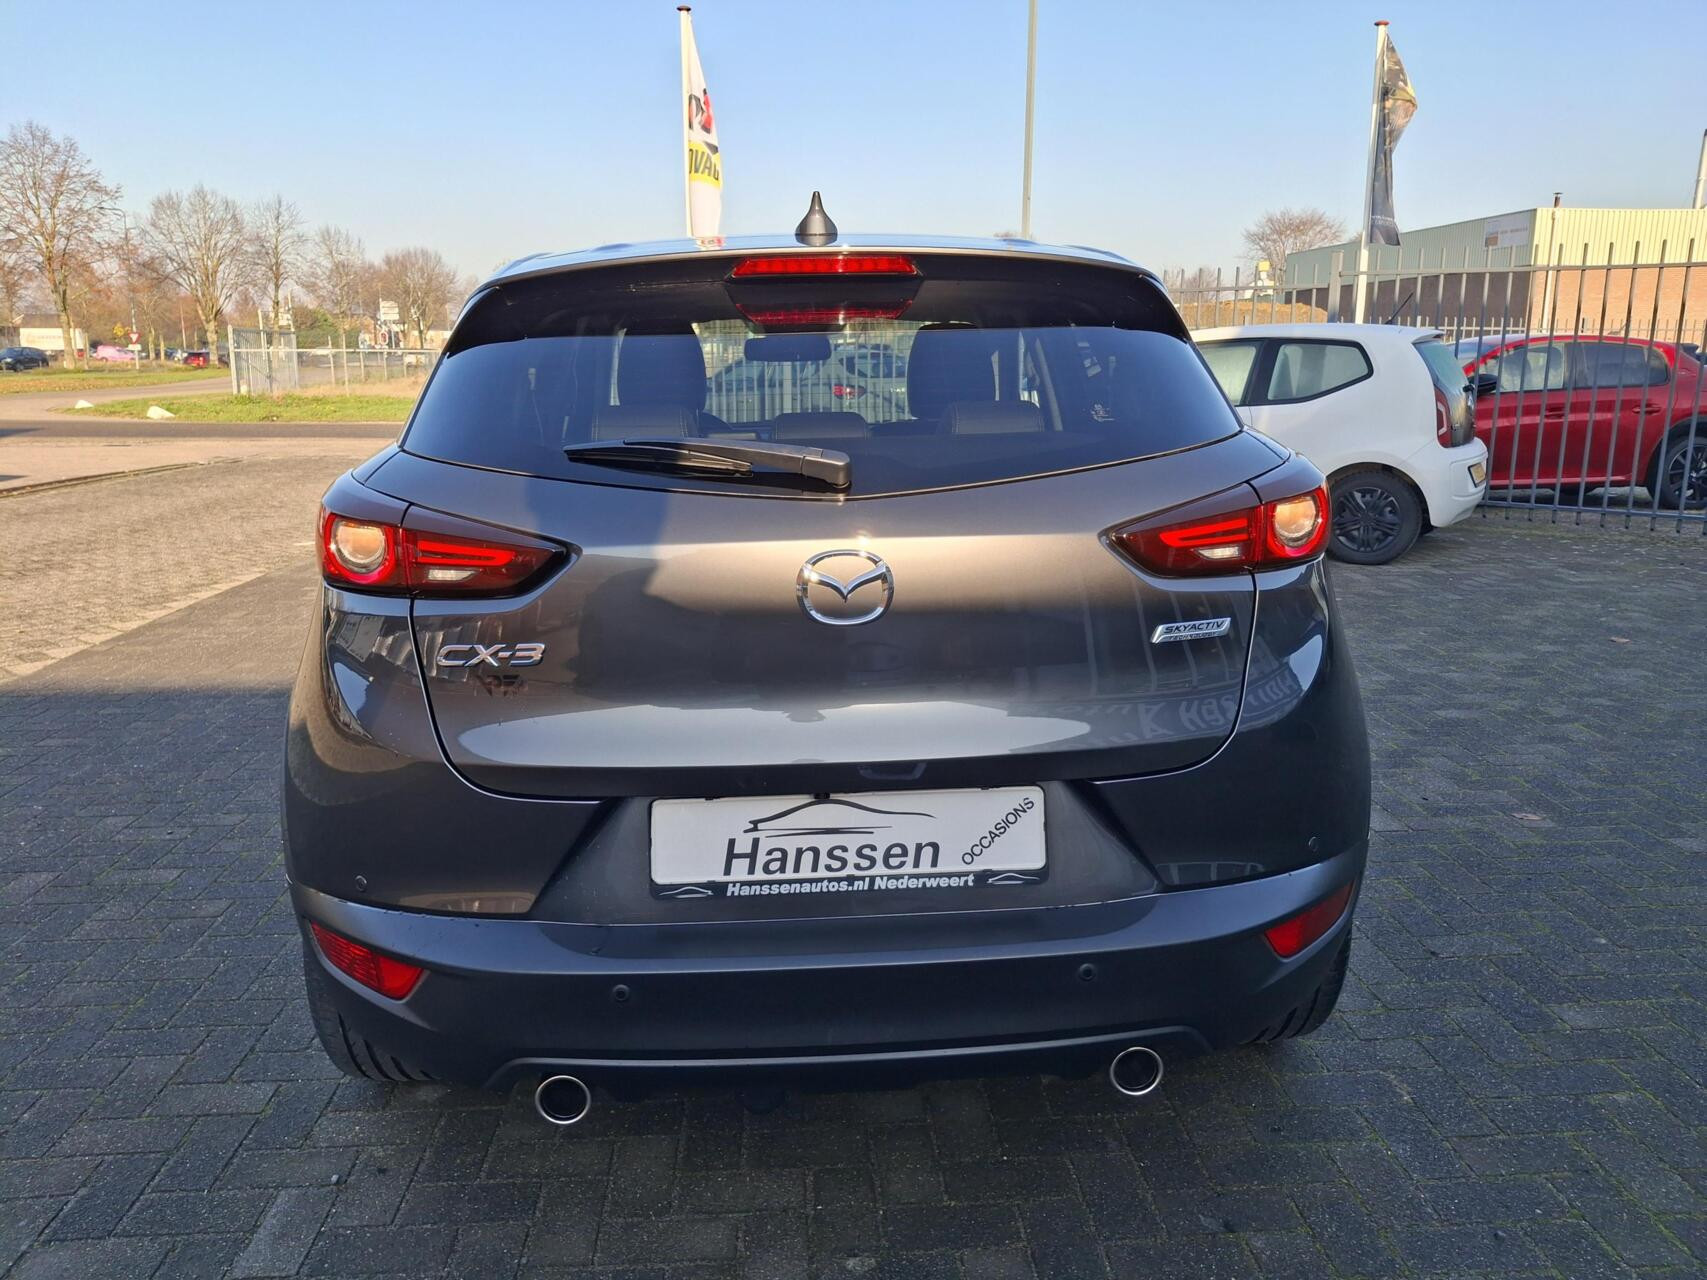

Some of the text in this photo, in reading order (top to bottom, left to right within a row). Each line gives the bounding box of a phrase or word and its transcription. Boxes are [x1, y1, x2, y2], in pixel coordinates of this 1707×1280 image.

[1163, 620, 1225, 634] SKYACTIV
[437, 643, 545, 667] CX-3
[961, 796, 1035, 866] OCCASIONS
[722, 837, 941, 877] Hanssen
[726, 872, 975, 897] Hanssenautos.nl Nederweert
